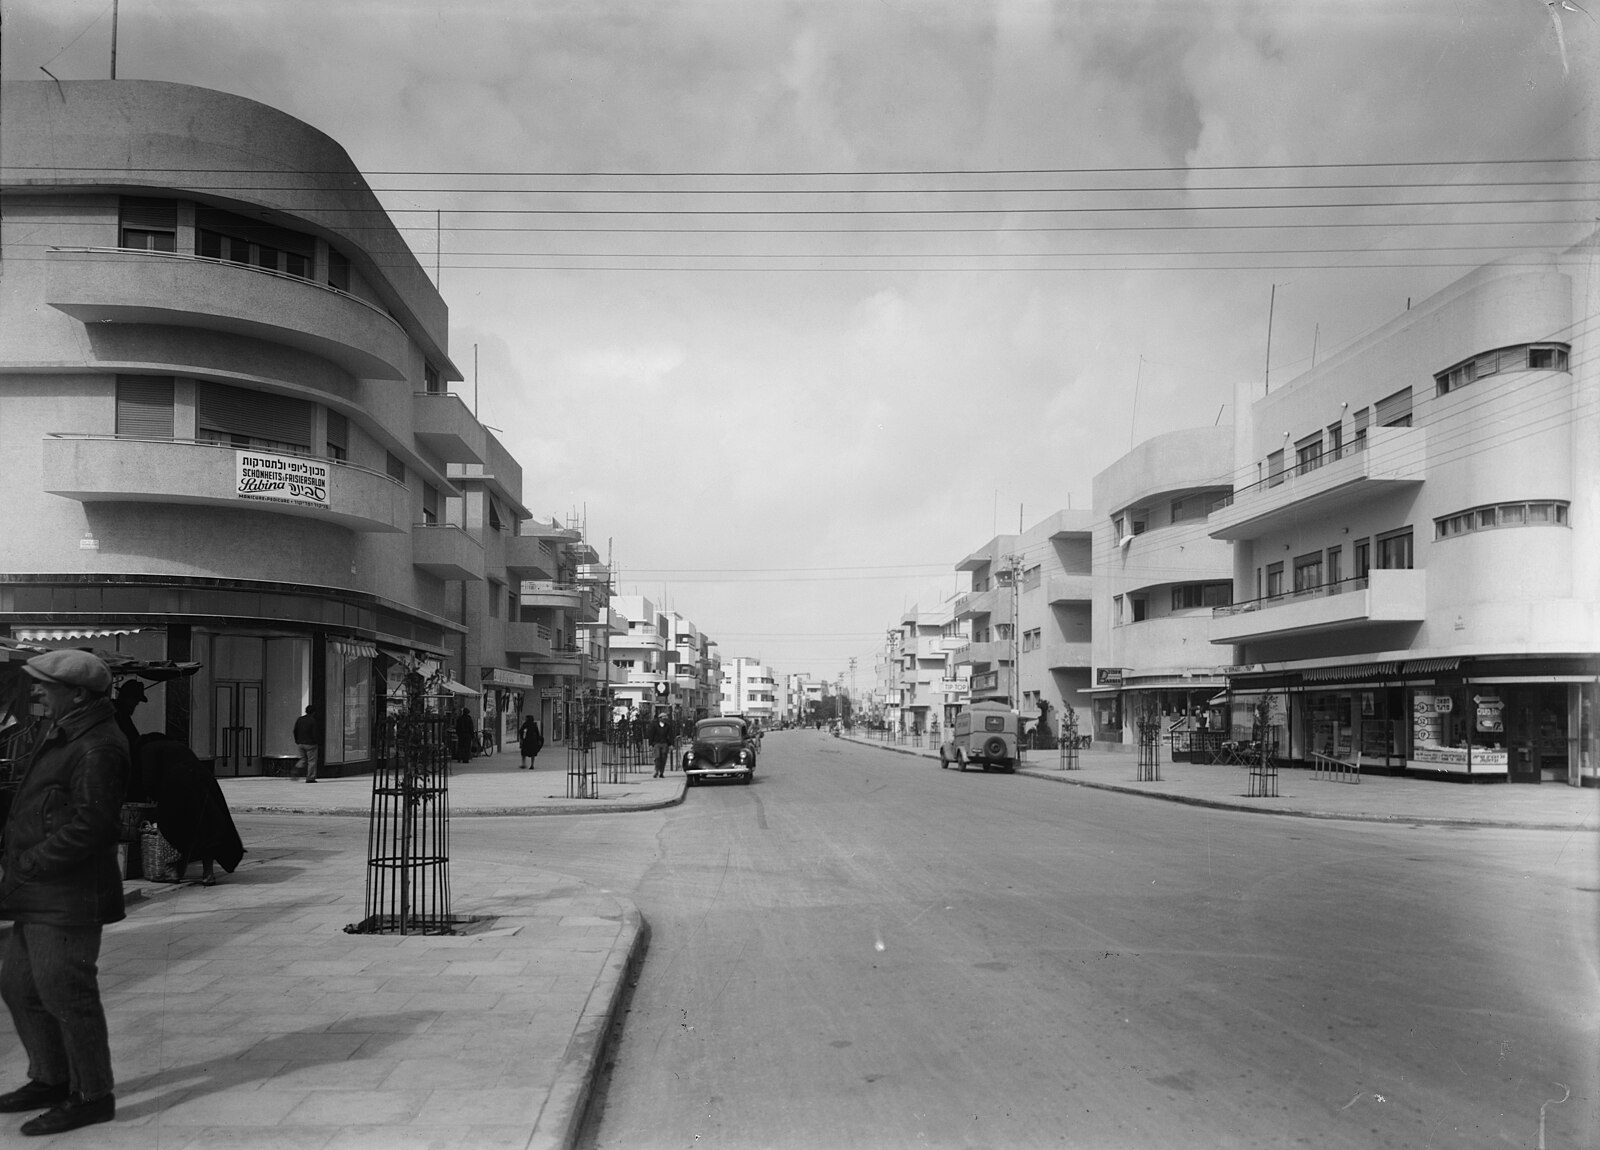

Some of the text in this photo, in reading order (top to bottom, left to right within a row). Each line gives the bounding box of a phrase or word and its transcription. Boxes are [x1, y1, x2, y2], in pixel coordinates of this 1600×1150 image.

[288, 463, 308, 474] ליופי
[309, 466, 326, 477] מכון
[238, 477, 286, 493] Sabina
